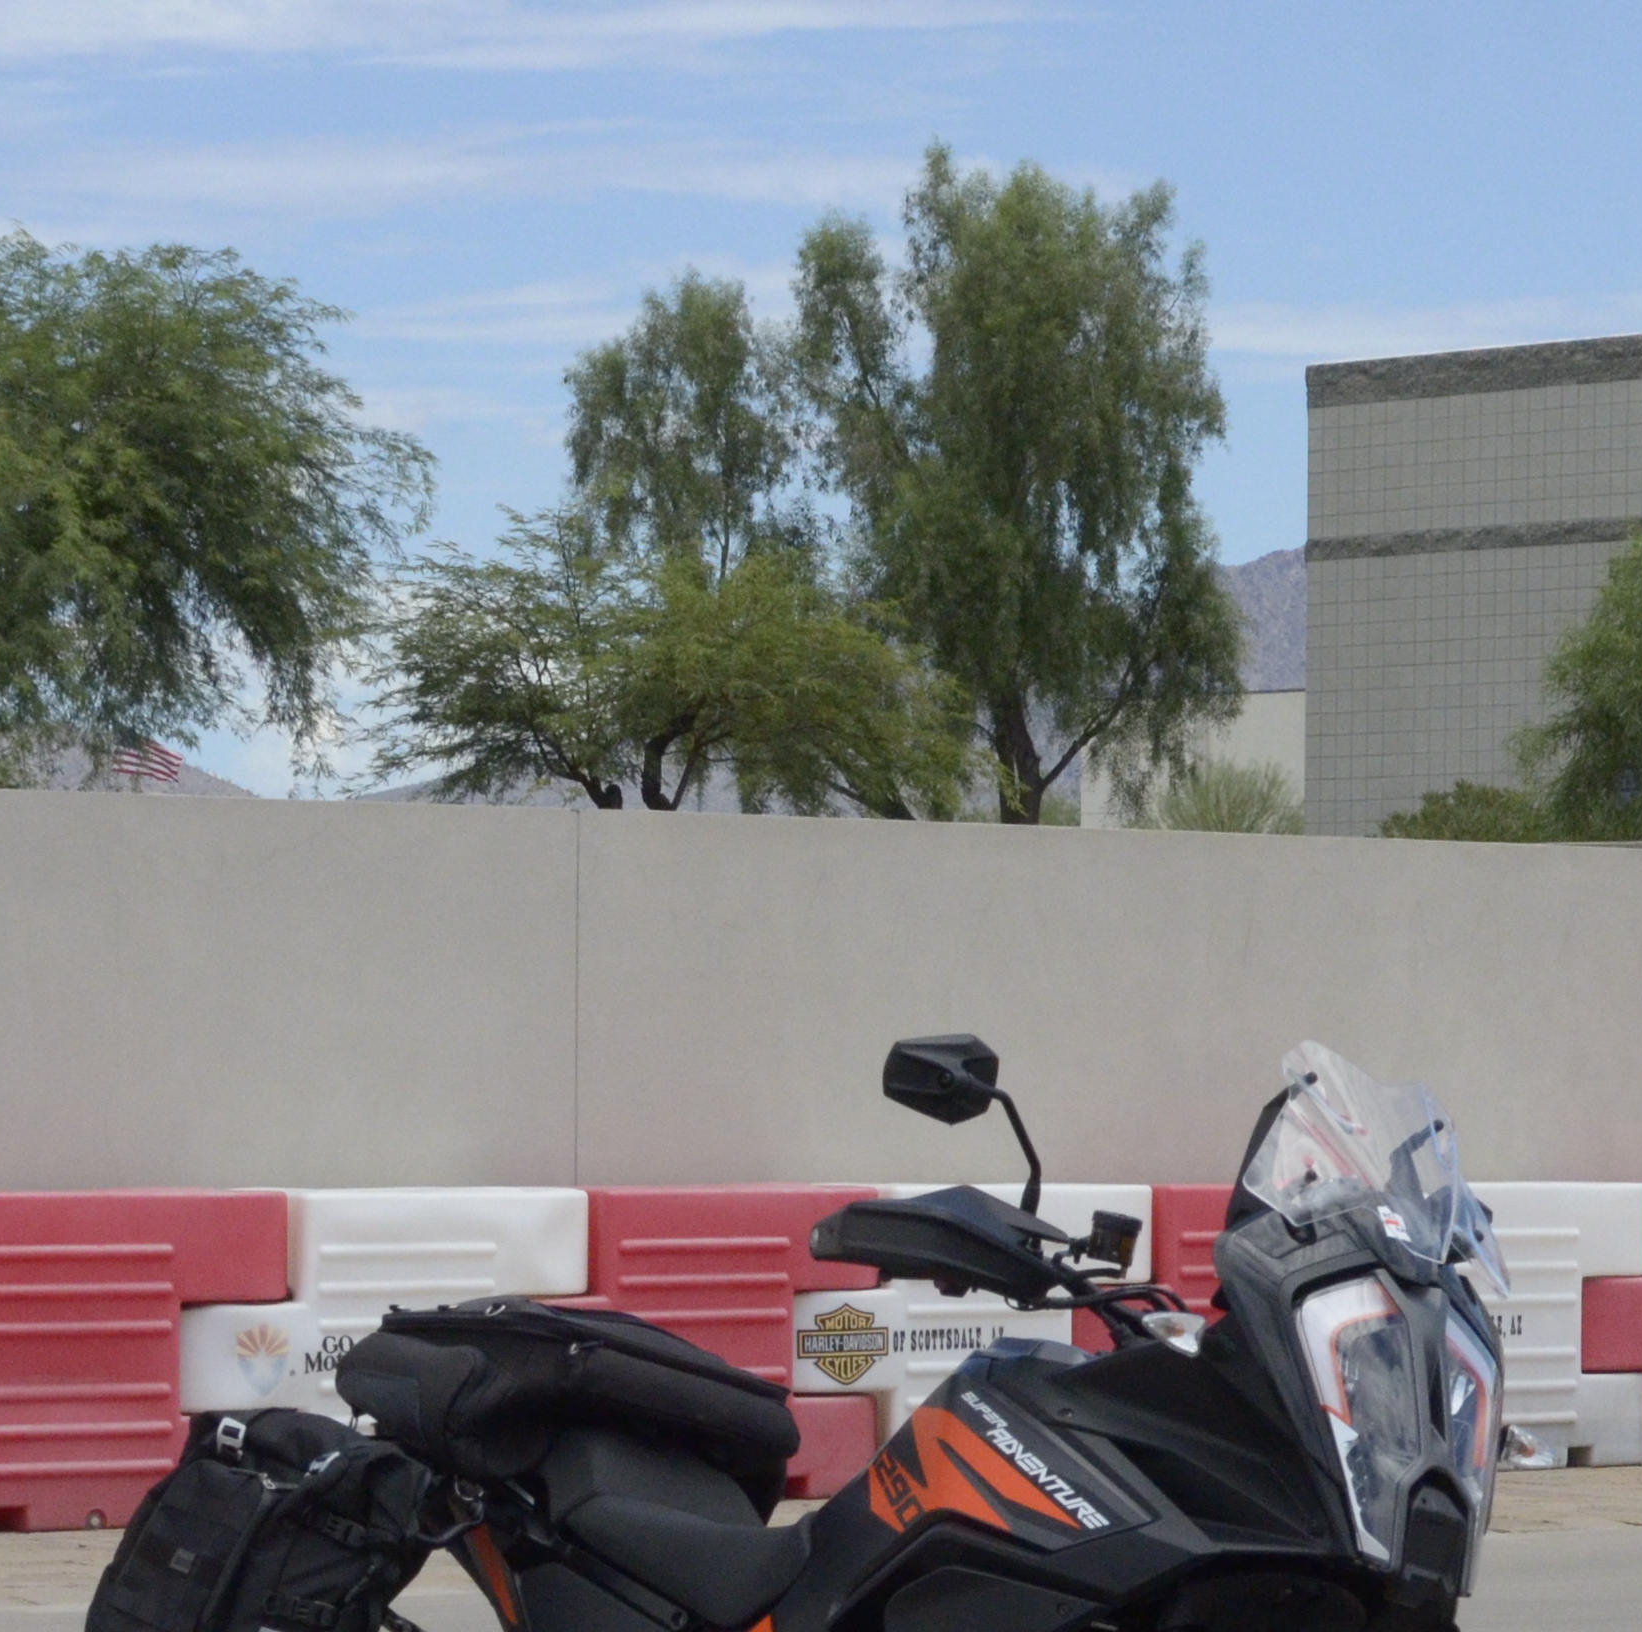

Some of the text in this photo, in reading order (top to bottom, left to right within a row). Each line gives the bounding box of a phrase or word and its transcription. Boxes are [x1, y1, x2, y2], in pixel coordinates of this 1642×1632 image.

[825, 1311, 867, 1330] MOTOR
[322, 1334, 355, 1354] GO
[804, 1333, 884, 1352] HARLEY-DAVIDSON
[825, 1356, 867, 1379] CYCLES
[960, 1391, 1008, 1429] SUPER
[986, 1426, 1111, 1530] ADVENTURE
